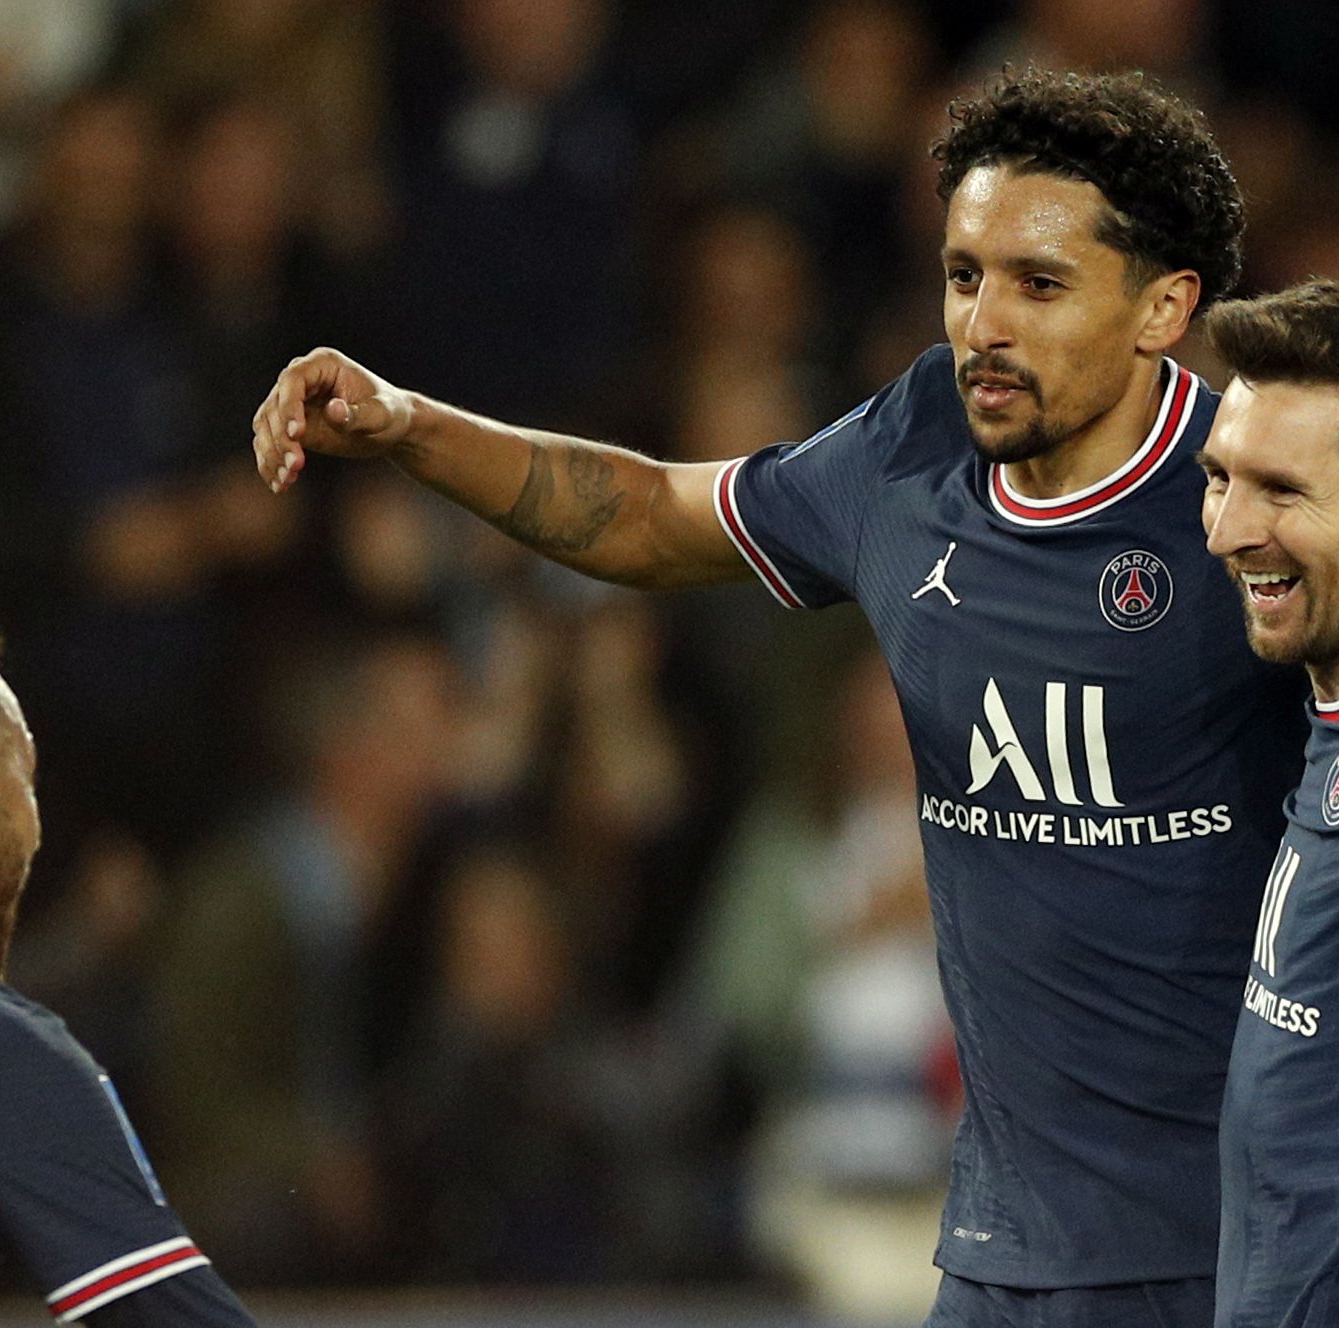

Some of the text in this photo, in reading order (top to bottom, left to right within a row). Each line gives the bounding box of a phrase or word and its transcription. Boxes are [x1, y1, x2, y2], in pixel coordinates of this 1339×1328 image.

[1111, 555, 1160, 575] PARIS
[921, 793, 1232, 846] ACCOR LIVE LIMITLESS
